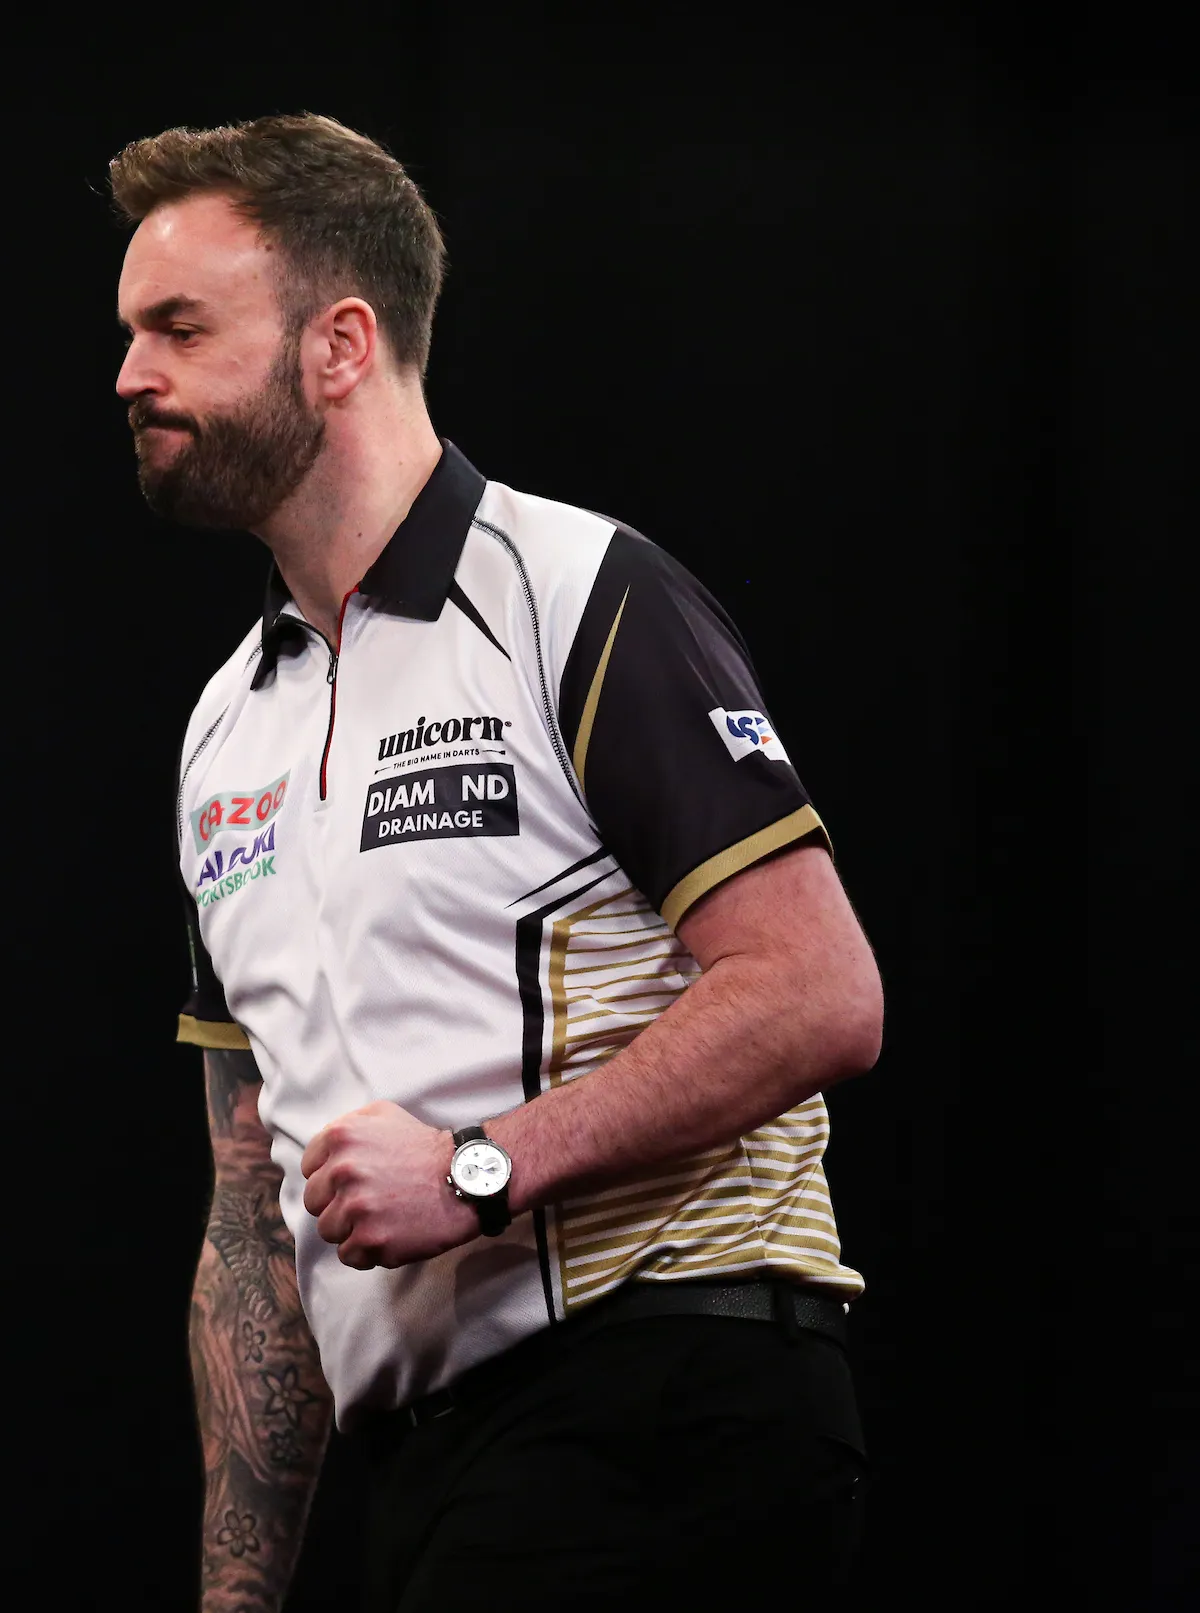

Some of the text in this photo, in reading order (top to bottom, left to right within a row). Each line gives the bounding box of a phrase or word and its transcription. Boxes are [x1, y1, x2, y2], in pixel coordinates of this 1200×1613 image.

[378, 716, 504, 761] unicorn
[393, 762, 406, 770] THE
[420, 753, 442, 763] NAME
[452, 748, 480, 757] DARTS
[378, 810, 484, 838] DRAINAGE
